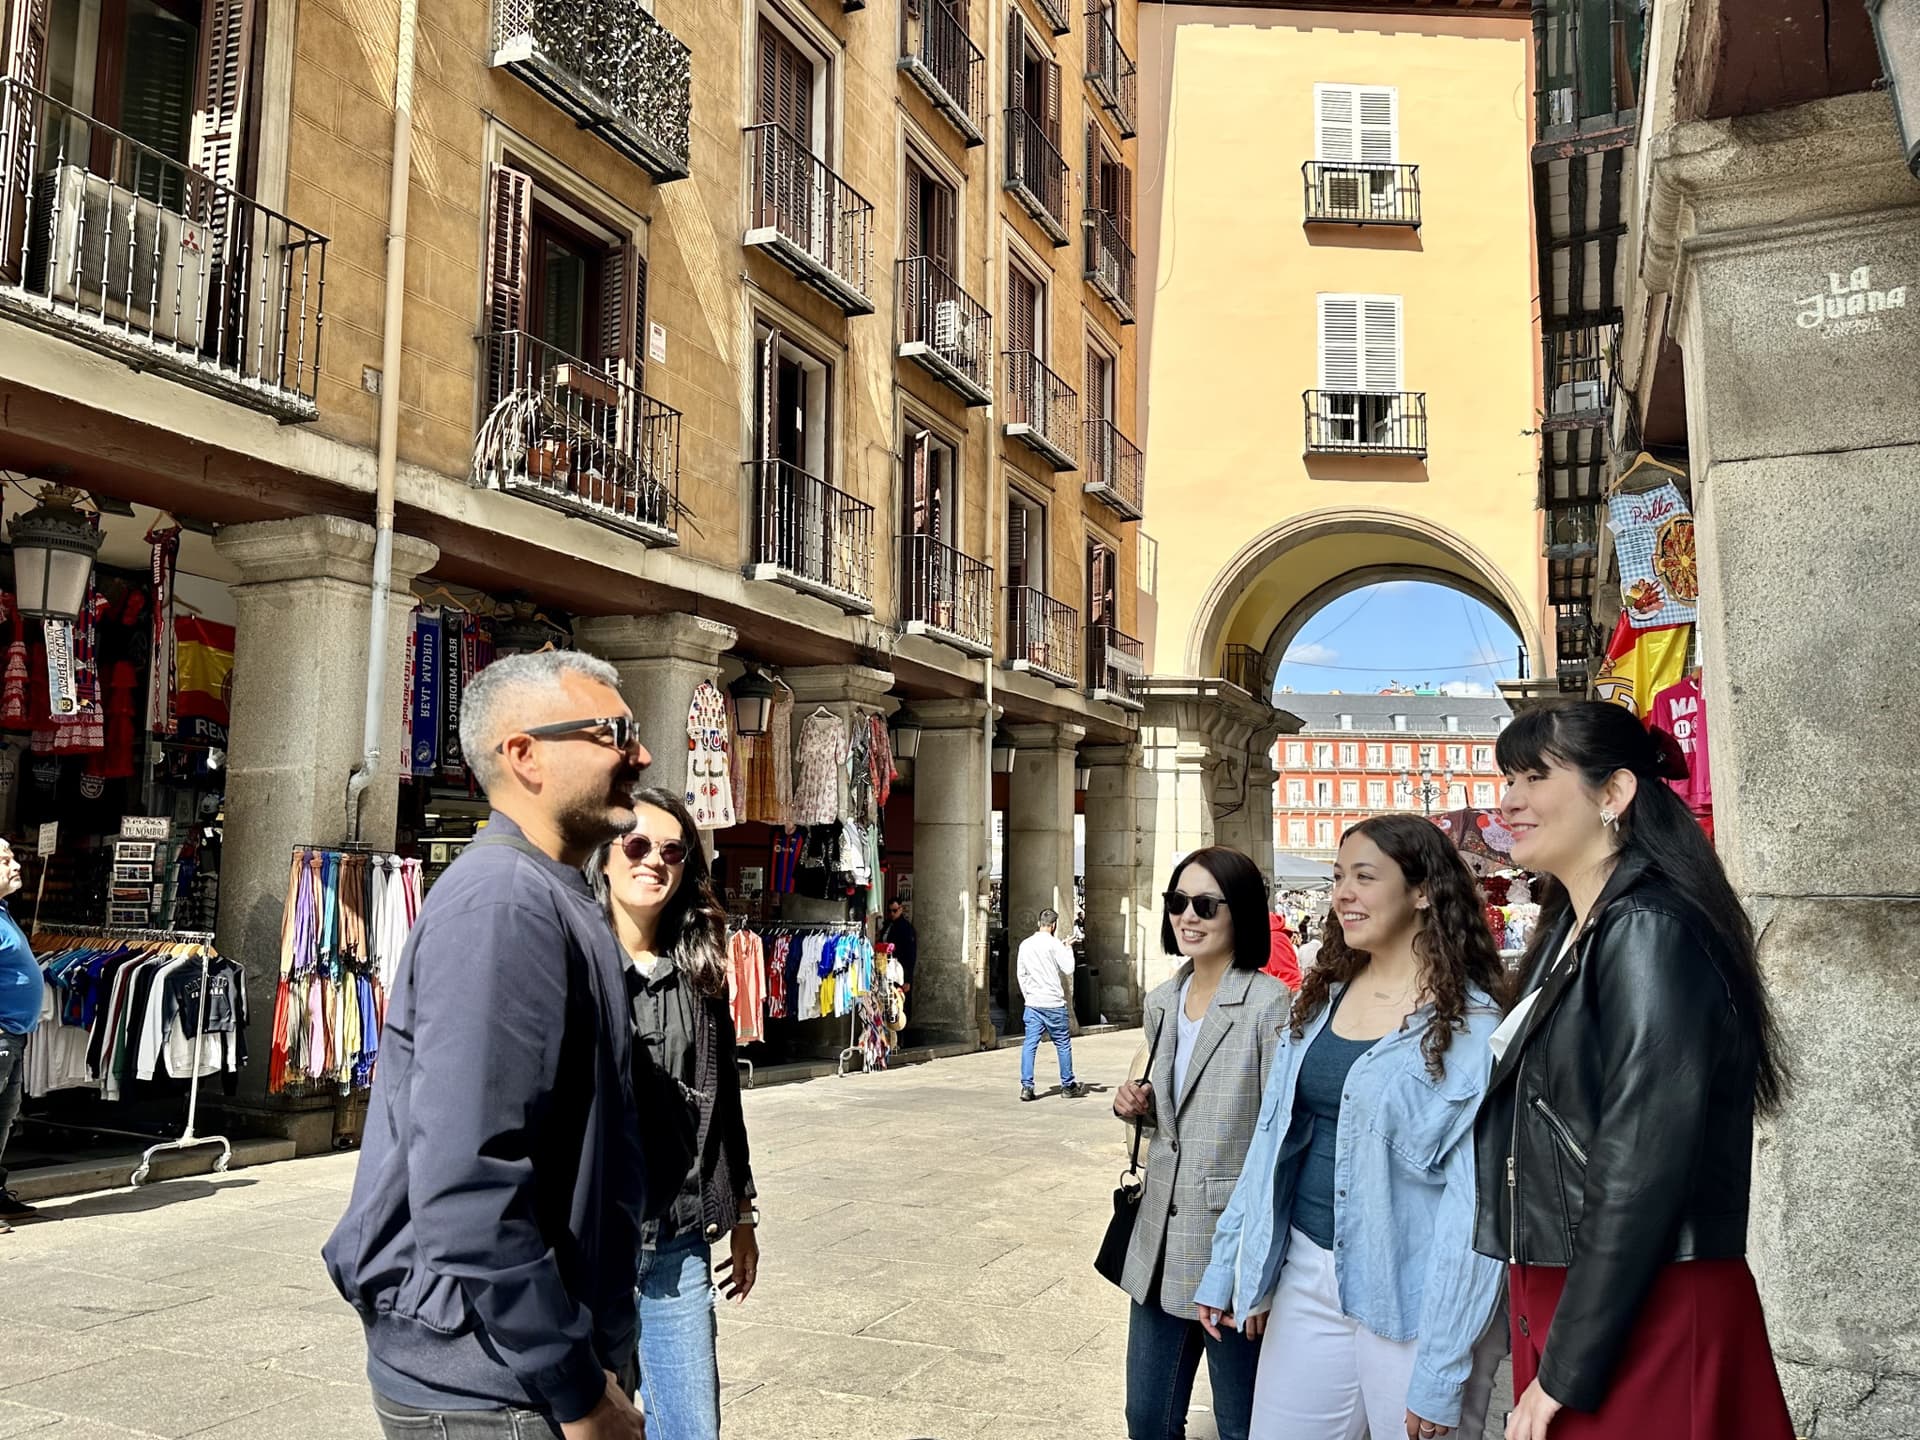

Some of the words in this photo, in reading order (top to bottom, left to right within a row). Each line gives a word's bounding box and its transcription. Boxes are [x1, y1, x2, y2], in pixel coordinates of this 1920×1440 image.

[1828, 265, 1870, 295] LA
[55, 628, 69, 695] ARGENTINA
[195, 718, 229, 744] REA
[1678, 723, 1687, 734] 11
